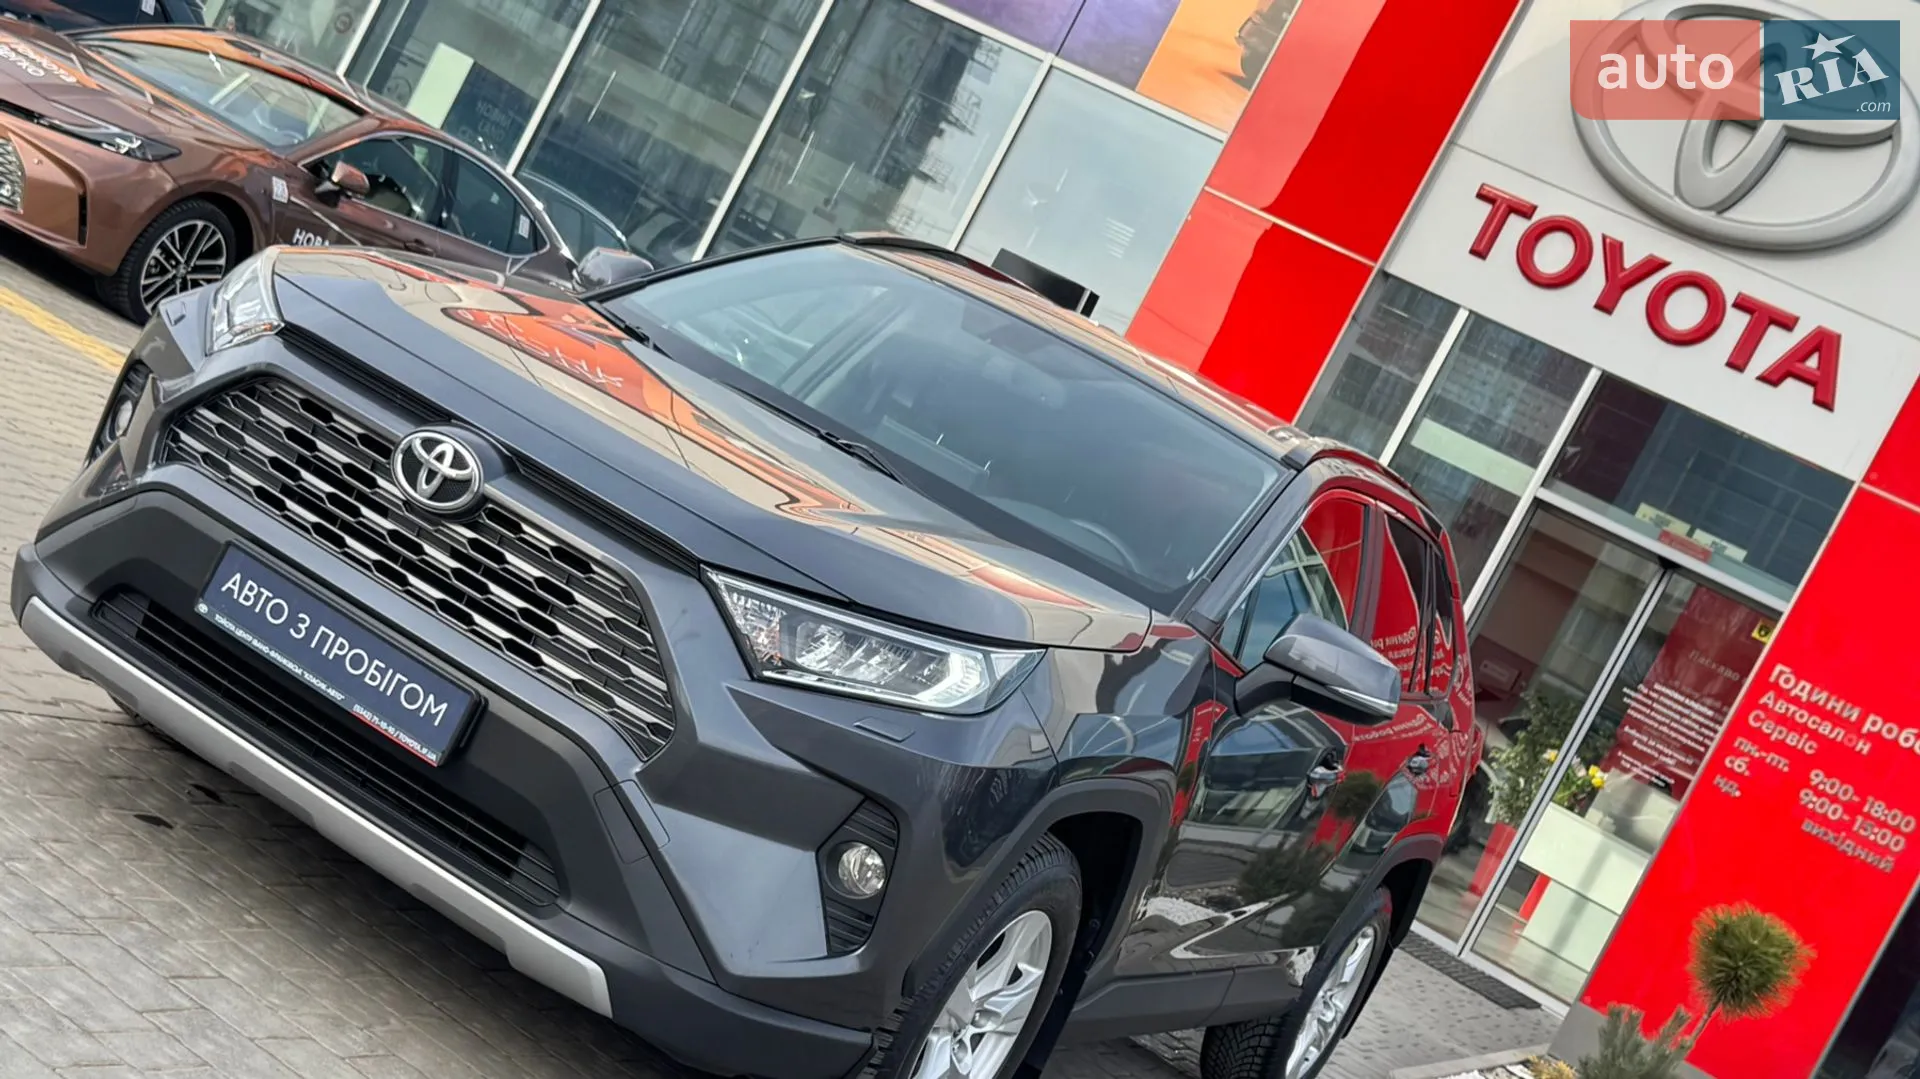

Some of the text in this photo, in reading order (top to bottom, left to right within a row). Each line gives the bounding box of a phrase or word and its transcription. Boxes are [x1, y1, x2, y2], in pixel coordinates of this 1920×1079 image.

[1468, 182, 1842, 413] TOYOTA
[221, 572, 448, 727] АВТО З ПРОБІГОМ
[1758, 690, 1872, 755] Автосалон
[1768, 663, 1861, 723] Години
[1748, 709, 1818, 755] Сервіс
[1724, 755, 1750, 776] сб.
[1713, 774, 1741, 797] нд.
[1801, 818, 1896, 873] вихідний
[1862, 795, 1916, 833] 18:00
